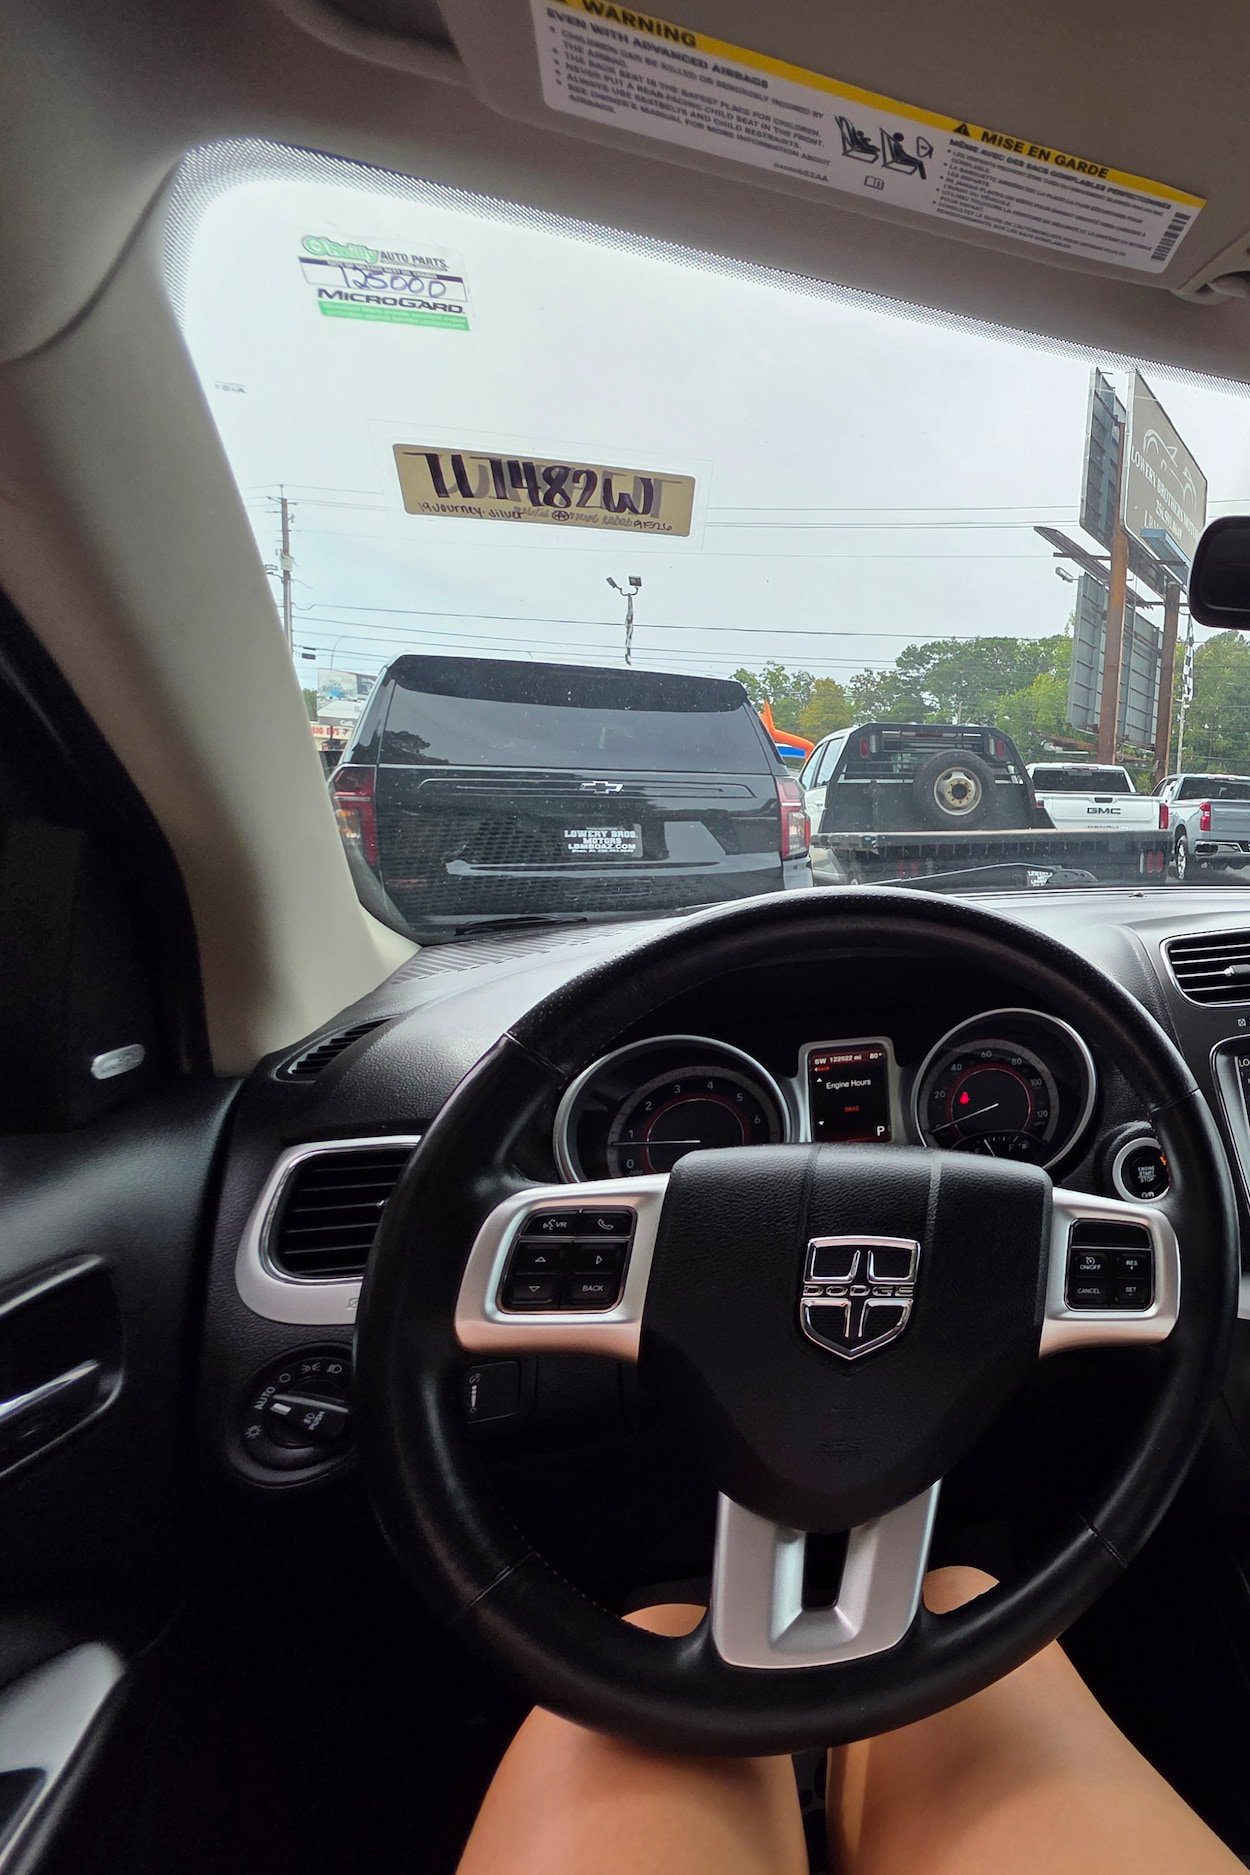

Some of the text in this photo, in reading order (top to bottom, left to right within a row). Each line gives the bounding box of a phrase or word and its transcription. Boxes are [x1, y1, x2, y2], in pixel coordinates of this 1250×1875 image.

[585, 0, 698, 48] WARNING
[590, 22, 629, 43] WITH
[632, 36, 708, 69] ADVANCED
[689, 110, 710, 122] AND
[981, 129, 1111, 179] MISE EN GARDE
[381, 250, 409, 263] AUTO
[564, 830, 638, 838] LOWERY BROS.
[981, 1050, 992, 1059] 60
[1011, 1057, 1023, 1066] 80
[1239, 1058, 1250, 1067] LO
[951, 1063, 962, 1072] 40
[707, 1081, 714, 1090] 4
[826, 1079, 871, 1089] Engine Hours
[1030, 1078, 1043, 1087] 100
[674, 1085, 681, 1094] 3
[736, 1093, 743, 1102] 5
[934, 1090, 946, 1099] 20
[645, 1101, 652, 1111] 2
[1037, 1109, 1048, 1118] 120
[754, 1115, 761, 1124] 6
[628, 1129, 634, 1138] 1
[876, 1126, 886, 1136] P
[627, 1159, 634, 1169] 0
[802, 1285, 914, 1296] DODGE
[253, 1386, 275, 1410] AUTO
[308, 1410, 325, 1431] PUSH
